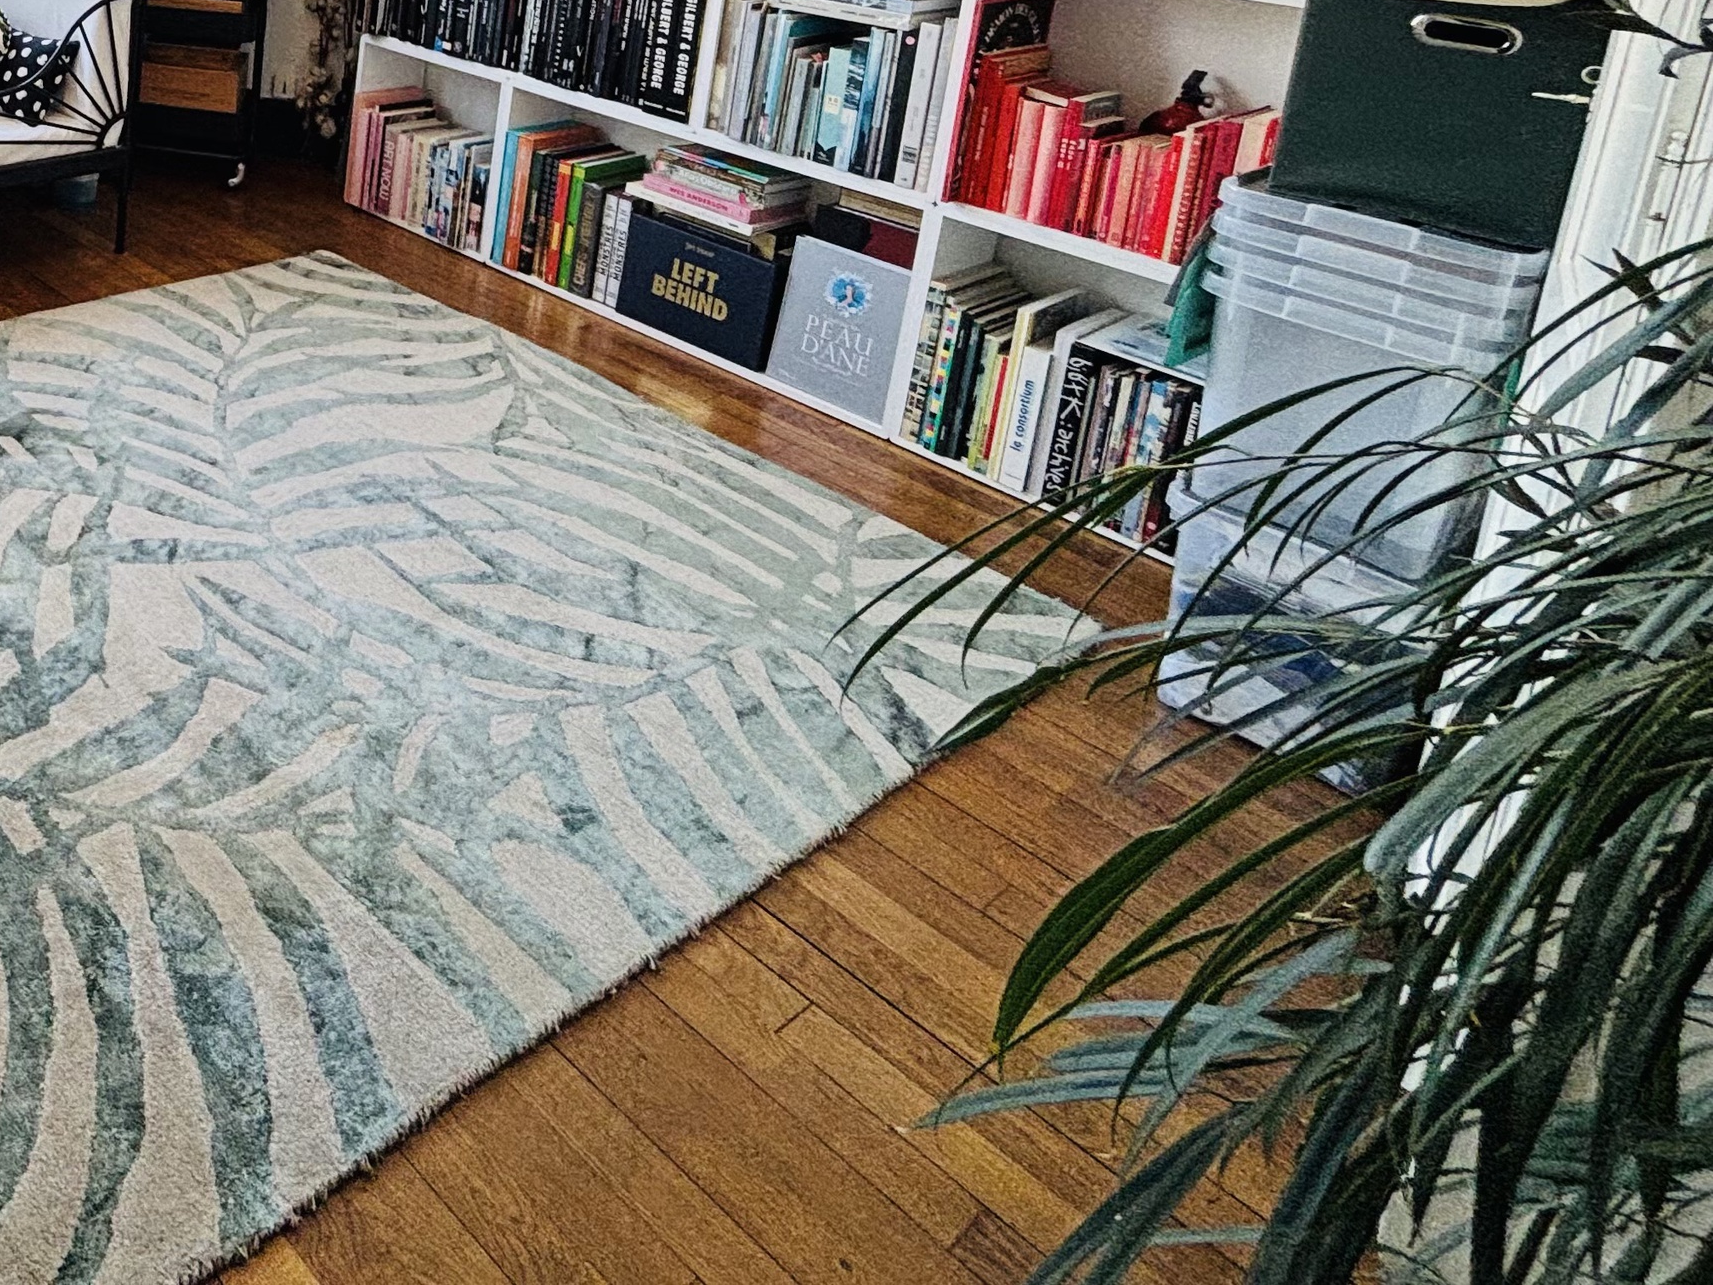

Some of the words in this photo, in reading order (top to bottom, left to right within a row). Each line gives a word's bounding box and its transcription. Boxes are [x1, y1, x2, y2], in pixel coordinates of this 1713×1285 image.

[656, 36, 668, 45] &
[679, 42, 691, 51] &
[650, 47, 666, 90] GEORGE
[673, 53, 690, 96] GEORGE
[382, 140, 394, 165] ART
[379, 166, 392, 201] NOW
[669, 186, 685, 196] WES
[687, 193, 728, 212] ANDERSON
[600, 226, 613, 276] MONSTRES
[613, 231, 626, 281] MONSTRES
[671, 257, 719, 294] LEFT
[651, 273, 728, 321] BEHIND
[806, 314, 874, 356] PEAU
[1014, 379, 1034, 438] consortium
[1009, 439, 1021, 452] le
[1044, 428, 1074, 491] archives
